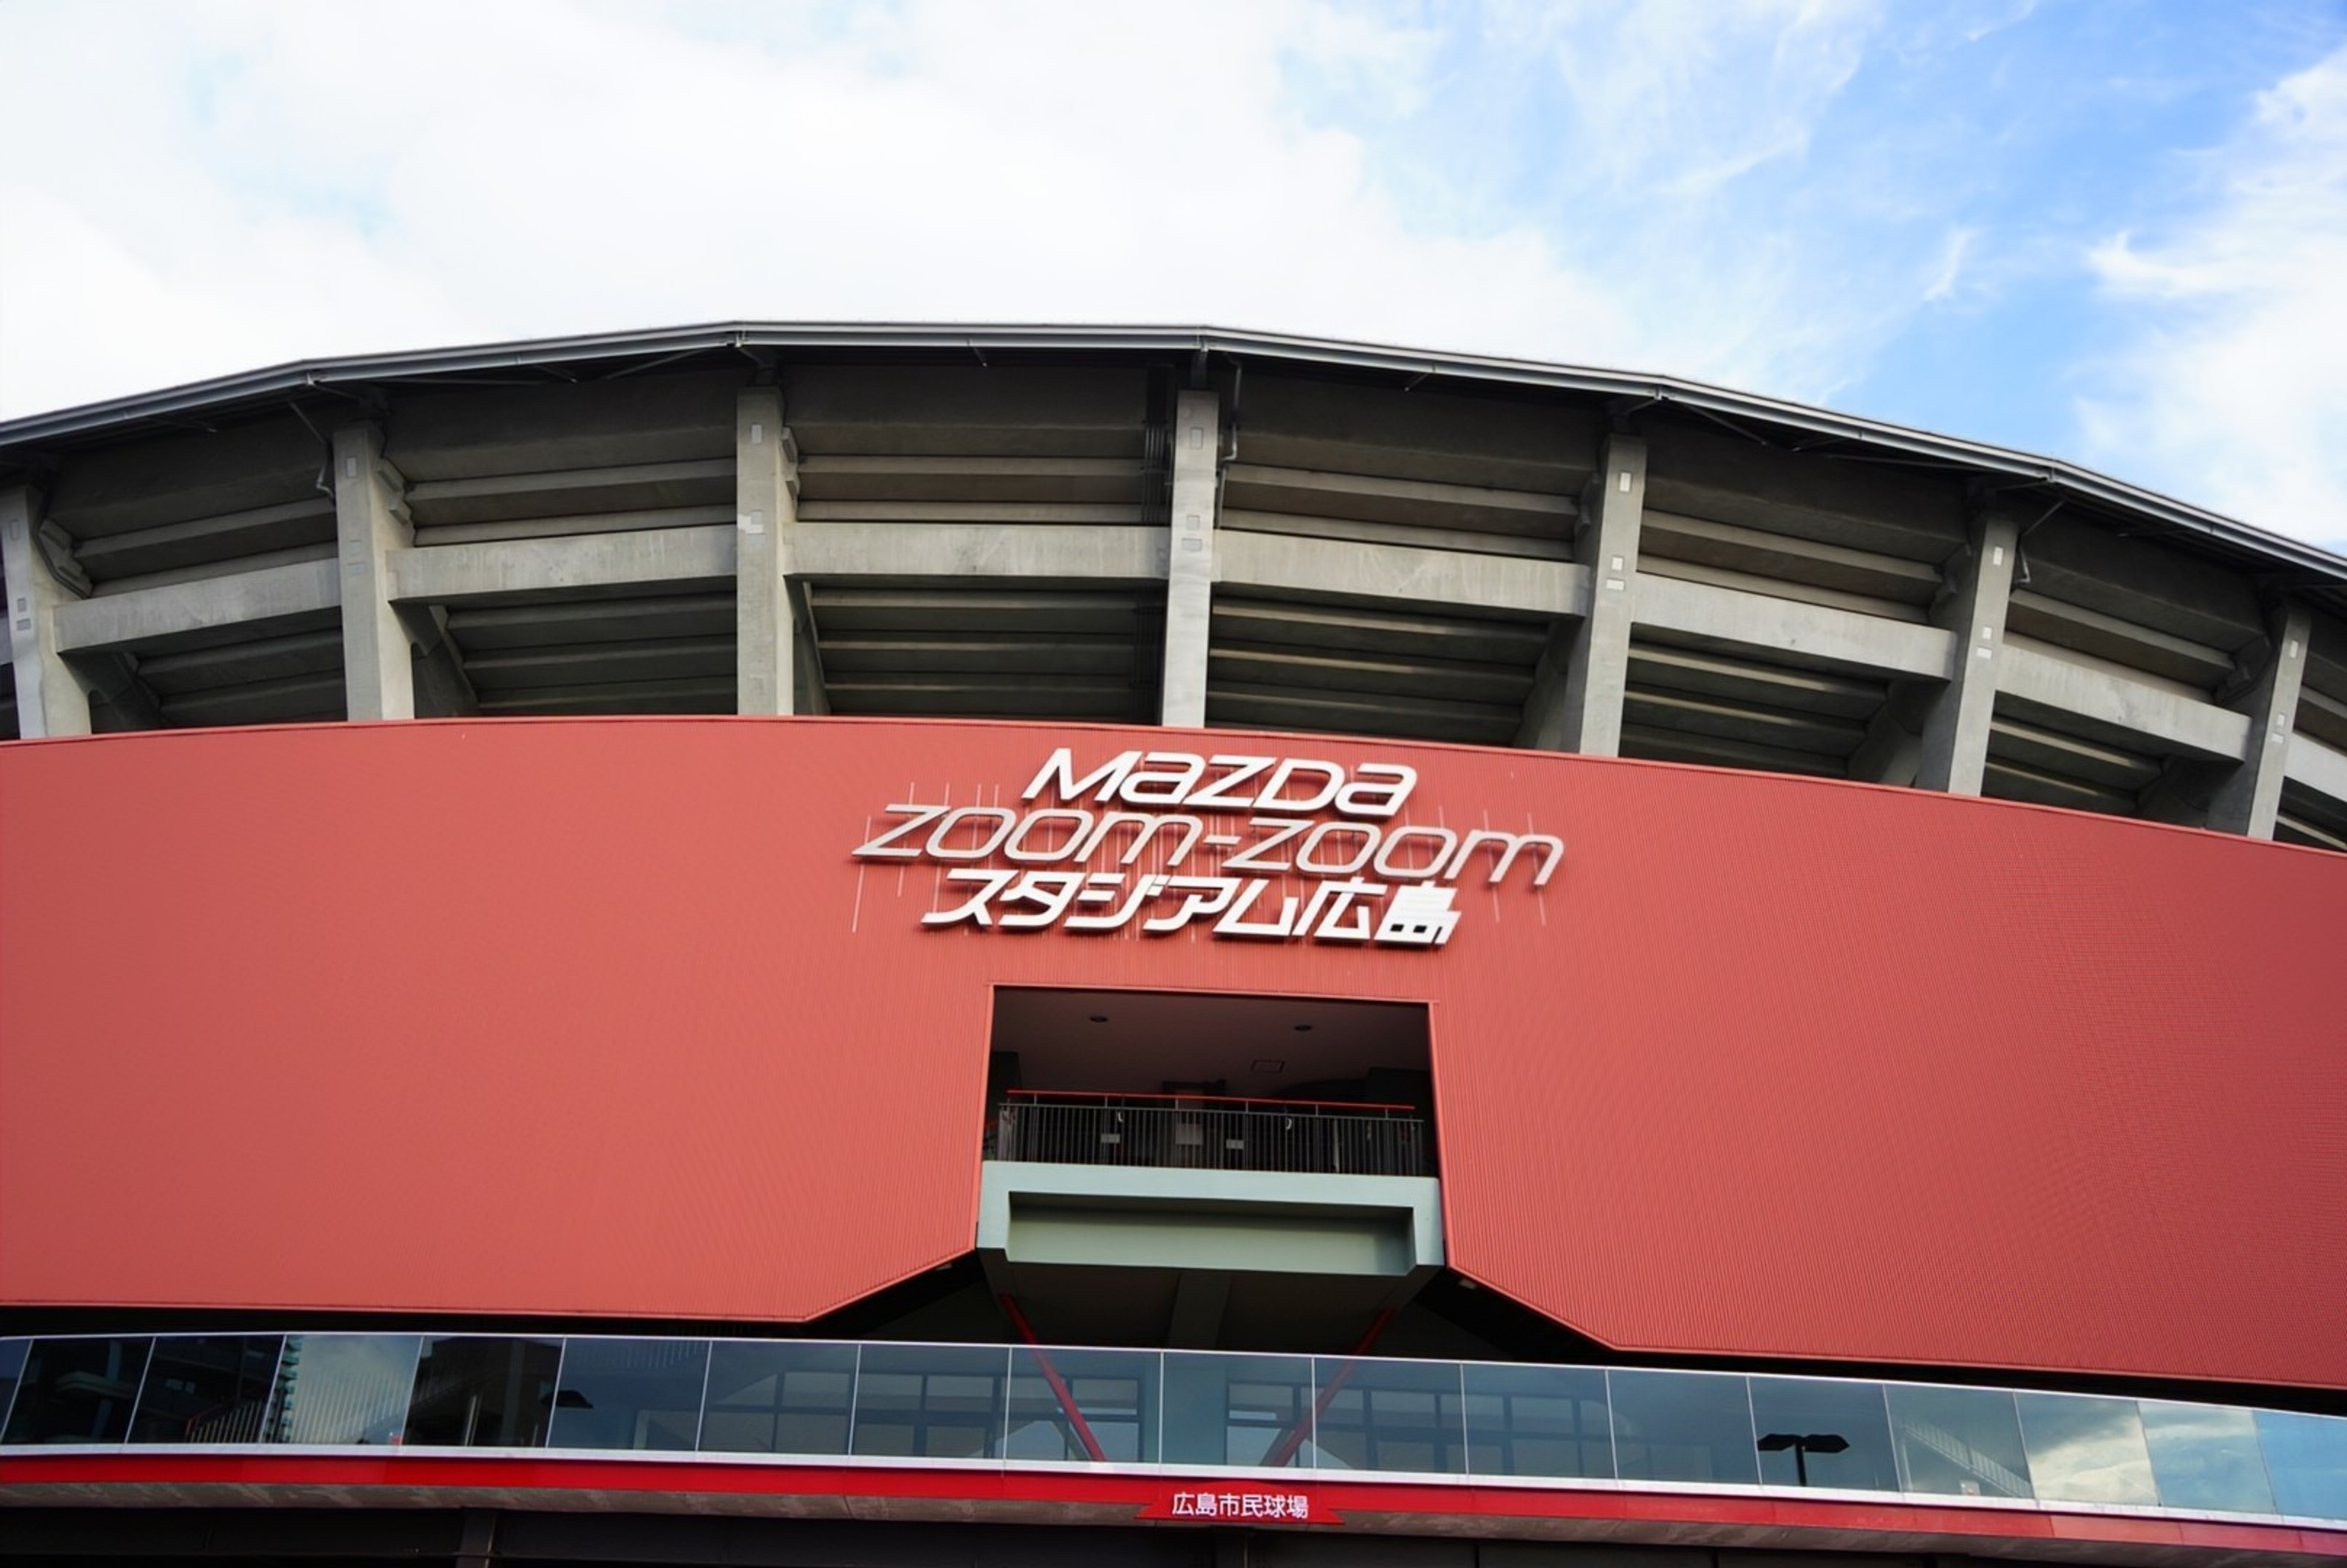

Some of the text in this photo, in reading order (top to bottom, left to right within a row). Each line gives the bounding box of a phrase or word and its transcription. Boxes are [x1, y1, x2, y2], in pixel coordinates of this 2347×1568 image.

[920, 868, 1462, 945] スタジアム広島
[1172, 1492, 1309, 1519] 広島市民球場
